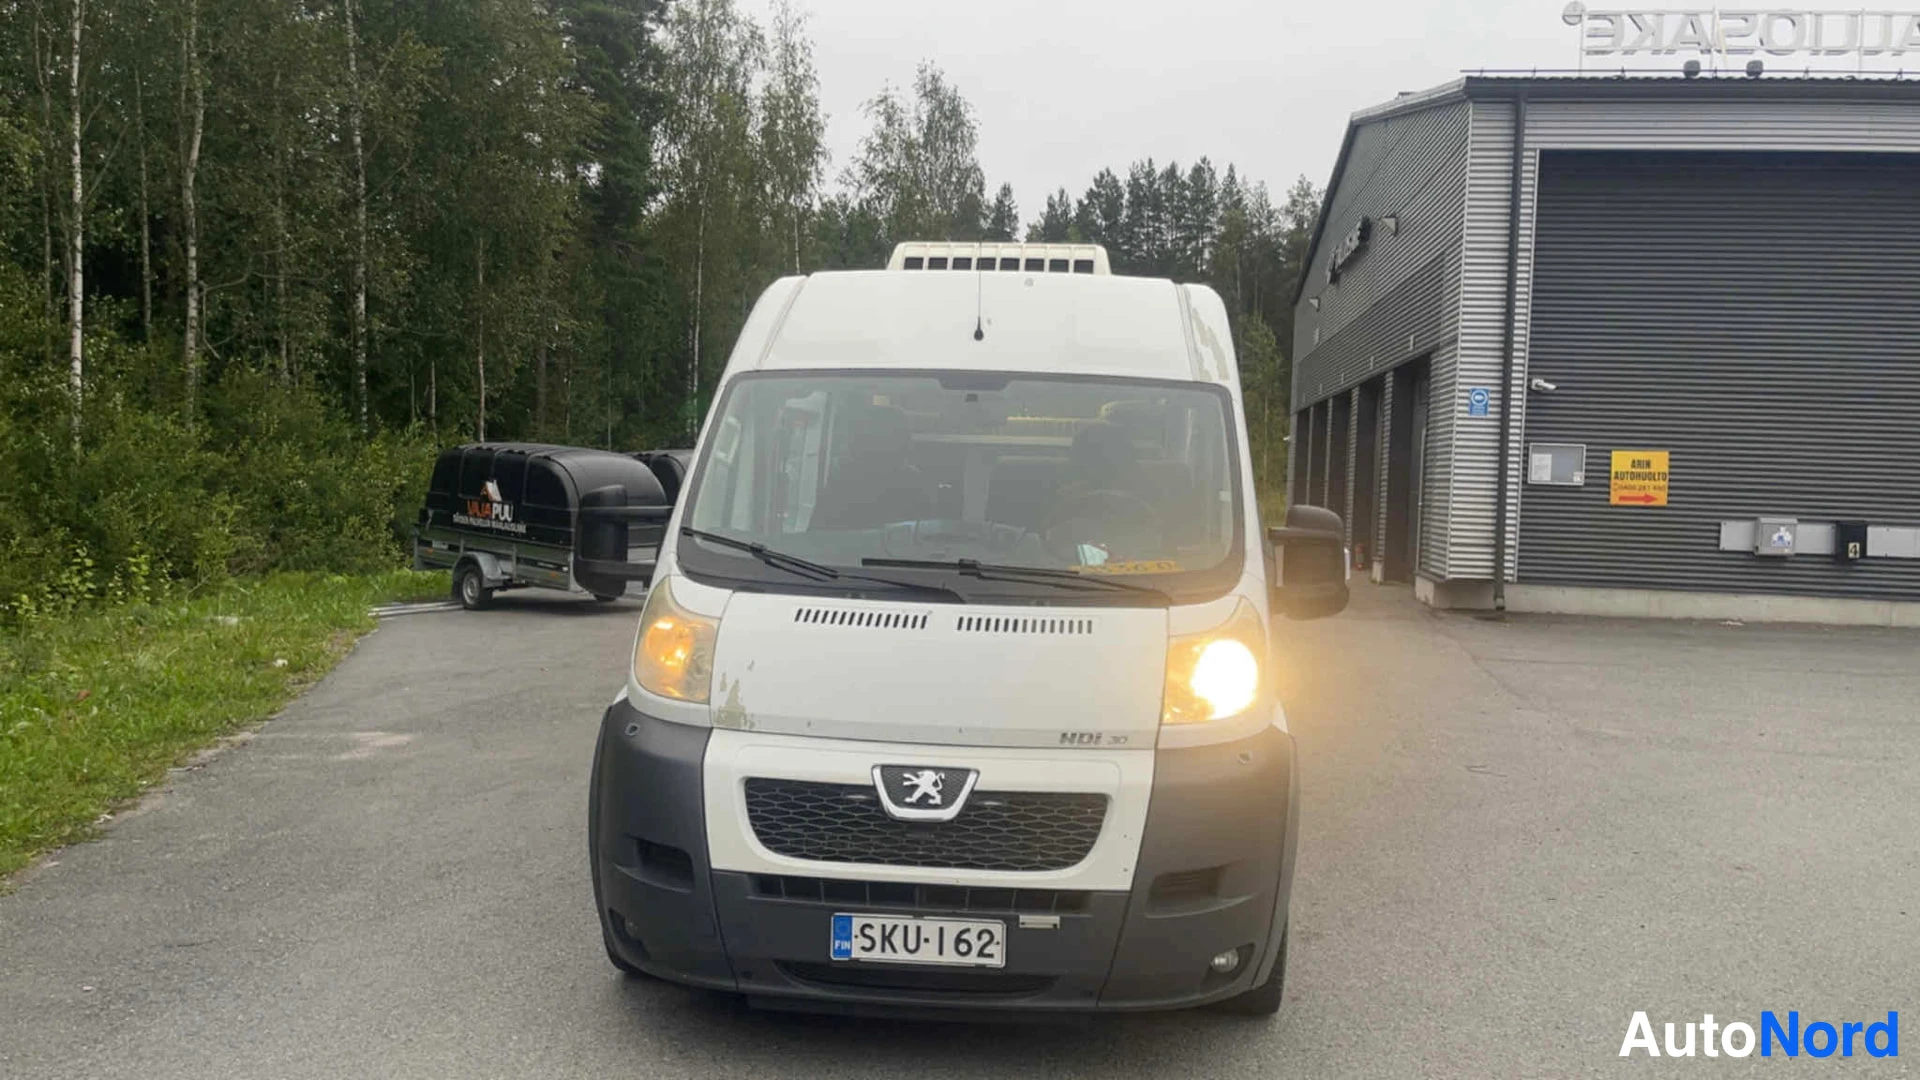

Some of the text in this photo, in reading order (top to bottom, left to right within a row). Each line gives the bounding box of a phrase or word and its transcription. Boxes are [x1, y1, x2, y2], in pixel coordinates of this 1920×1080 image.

[1614, 471, 1667, 481] AUTOHUOLTO
[1849, 544, 1858, 556] 4
[834, 923, 995, 958] FIN SKU-162
